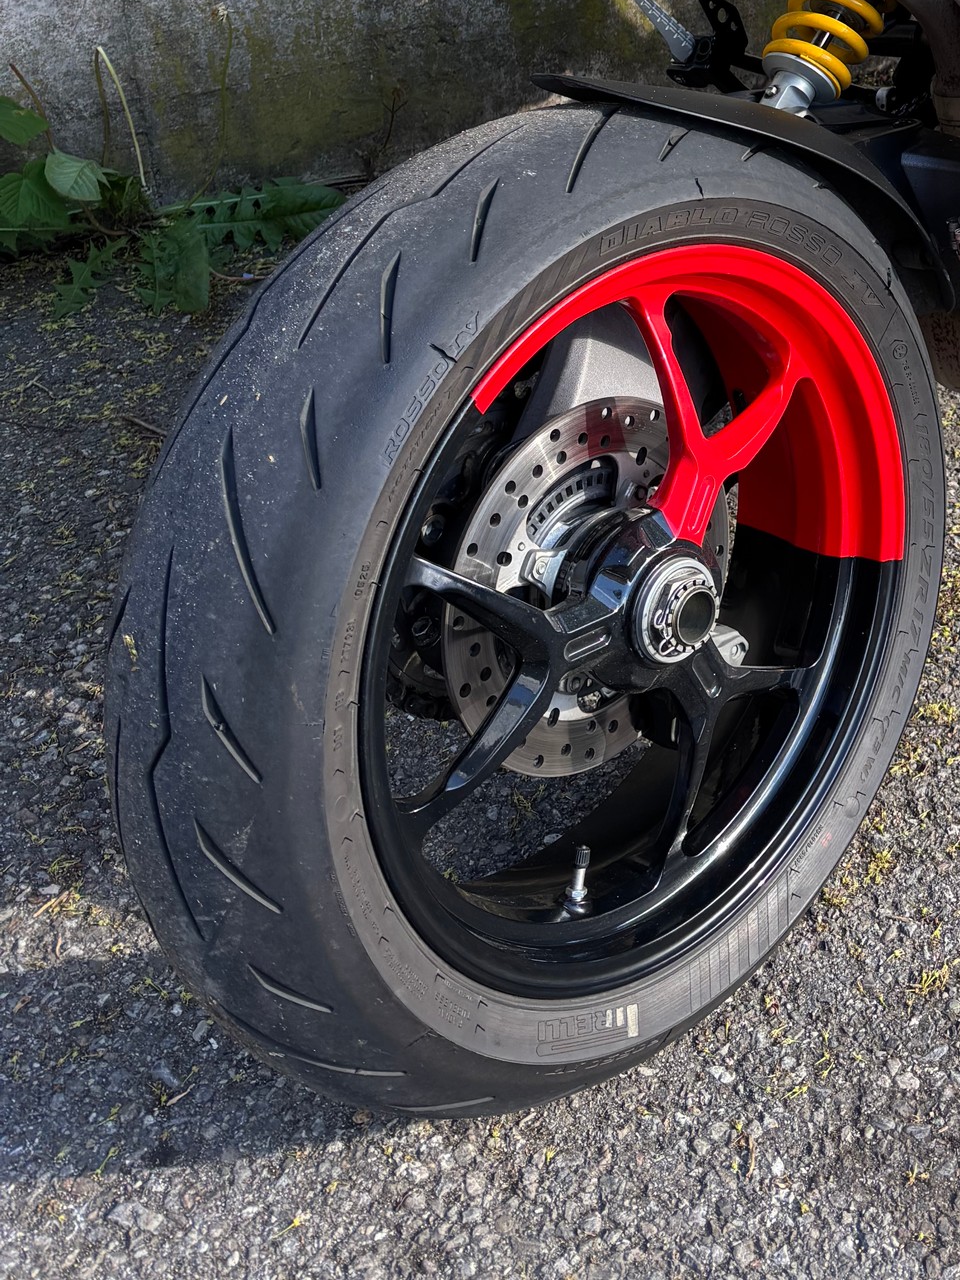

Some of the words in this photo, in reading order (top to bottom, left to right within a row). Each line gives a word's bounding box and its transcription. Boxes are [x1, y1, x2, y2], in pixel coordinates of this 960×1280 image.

[599, 207, 739, 257] DIABLO
[746, 210, 843, 267] ROSSO
[383, 355, 451, 468] ROSSO
[537, 1003, 640, 1050] PIRELLI
